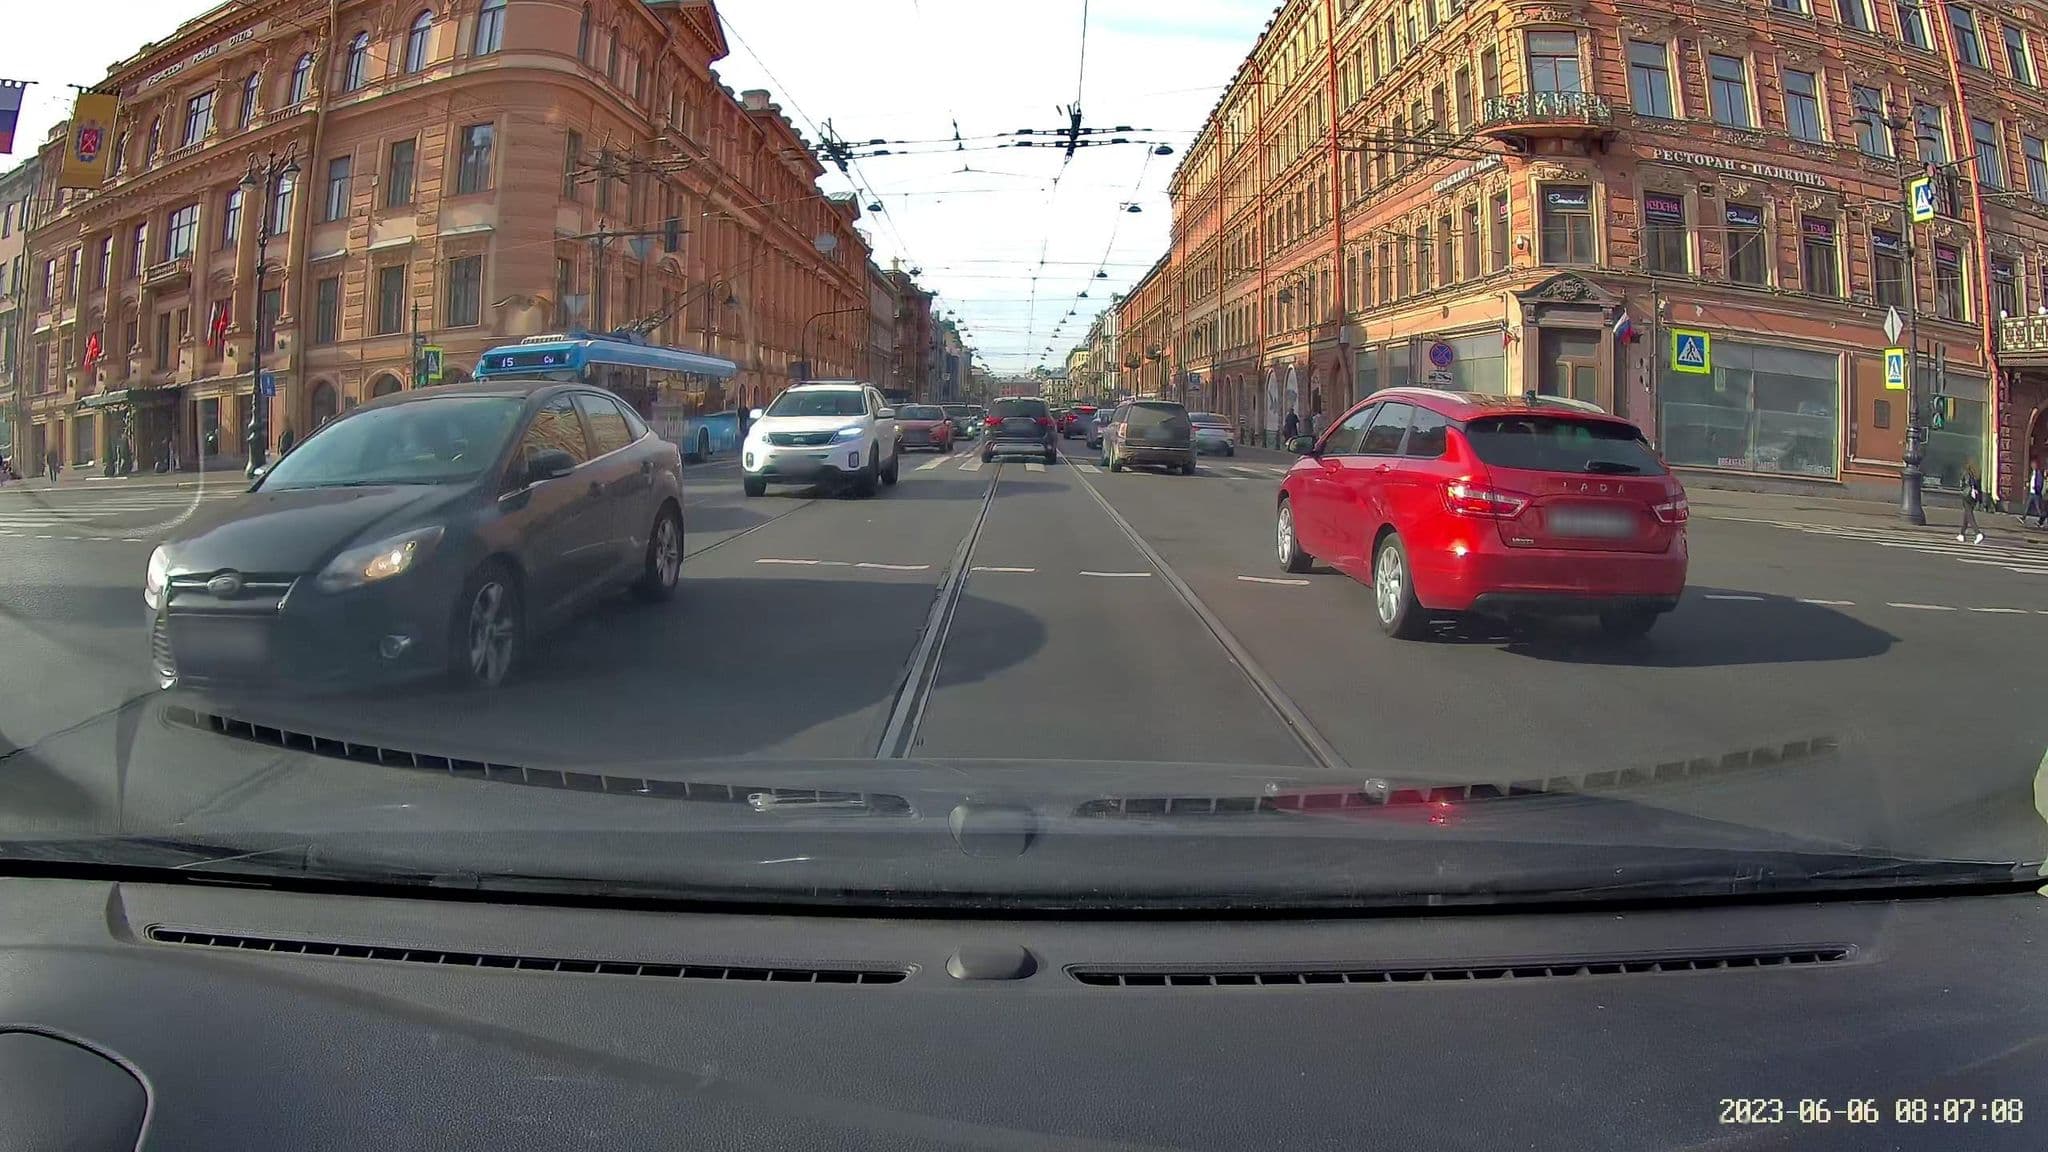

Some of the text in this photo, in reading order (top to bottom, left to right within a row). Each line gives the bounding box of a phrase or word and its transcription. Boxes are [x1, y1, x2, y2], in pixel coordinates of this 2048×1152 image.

[1652, 149, 1826, 187] РЕСТОРАН ПАЛКИНЪ
[502, 357, 514, 368] 15
